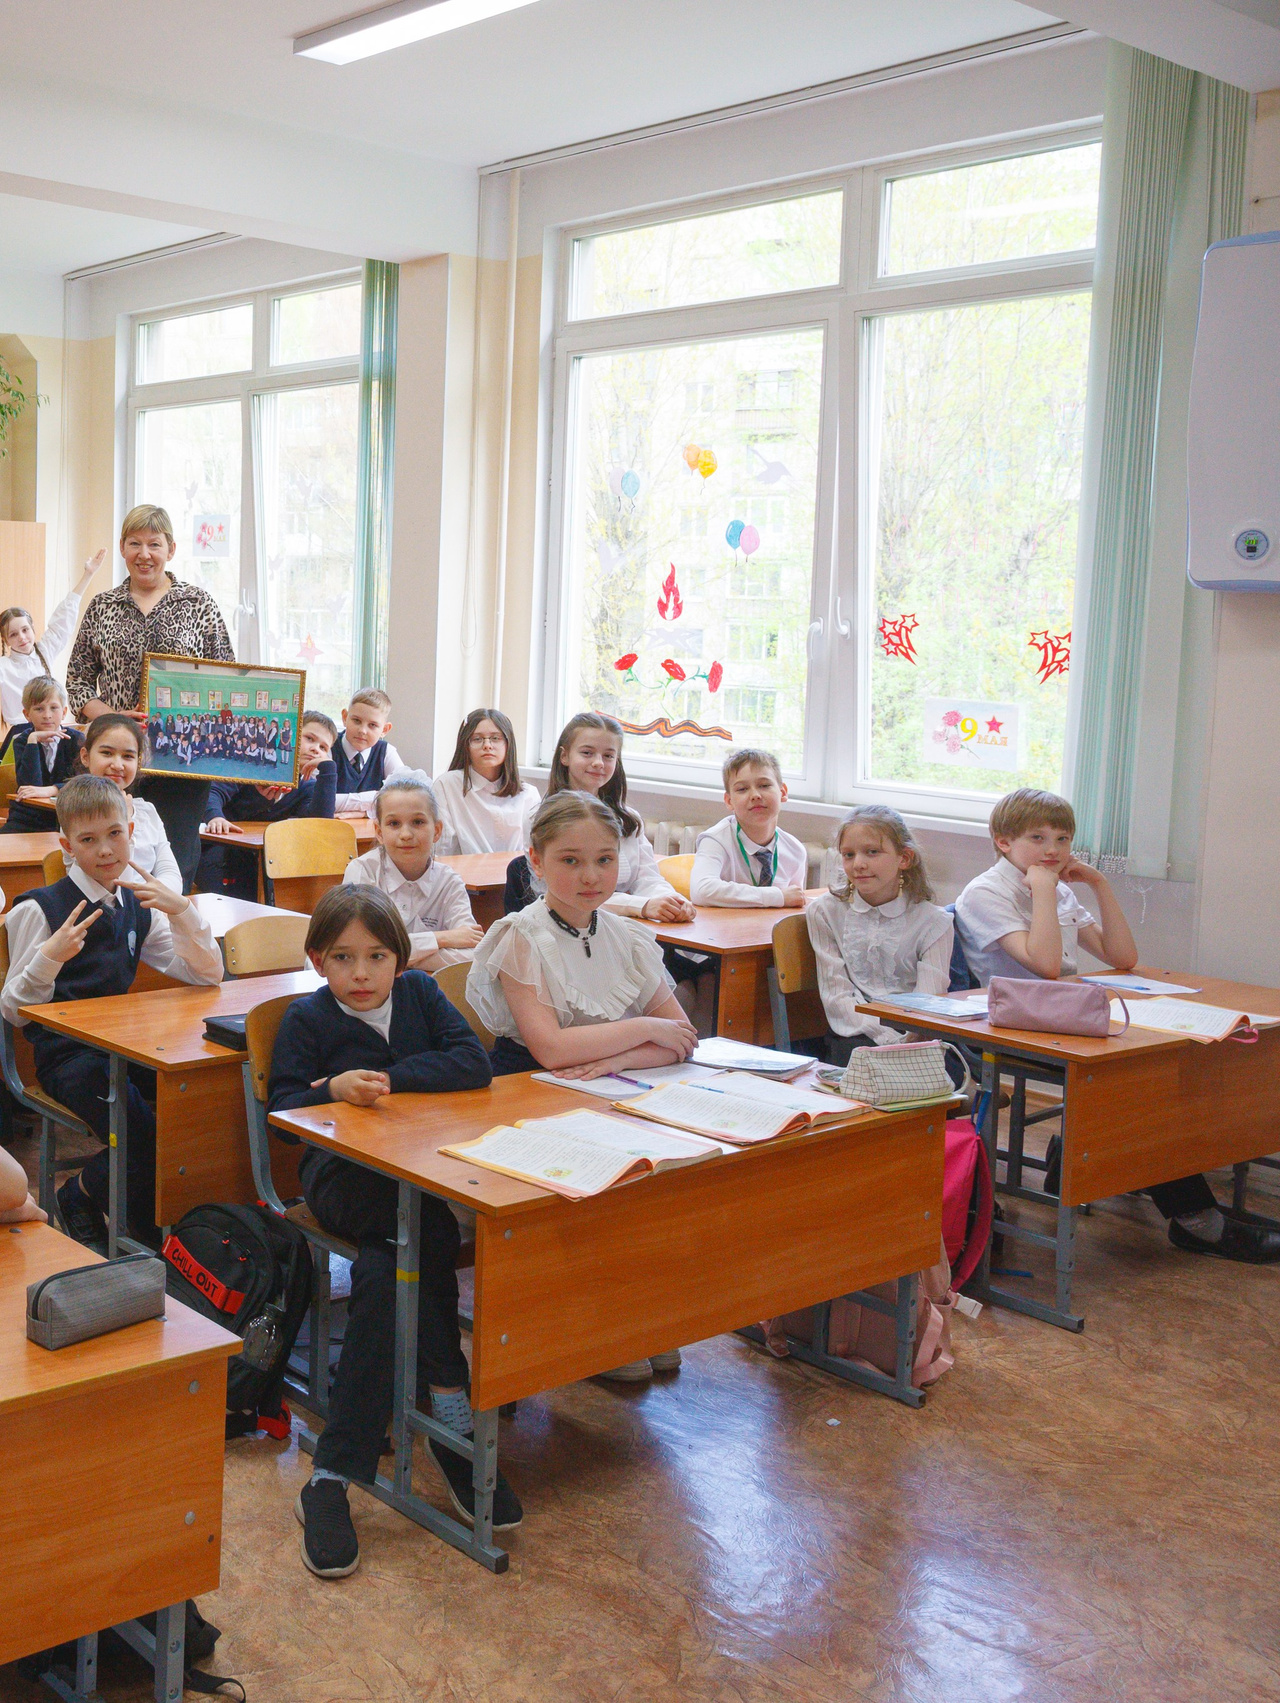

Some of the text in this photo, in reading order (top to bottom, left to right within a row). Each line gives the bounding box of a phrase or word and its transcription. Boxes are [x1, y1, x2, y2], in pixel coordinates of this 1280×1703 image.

[960, 717, 978, 742] 9
[172, 1248, 218, 1298] CHILL OUT
